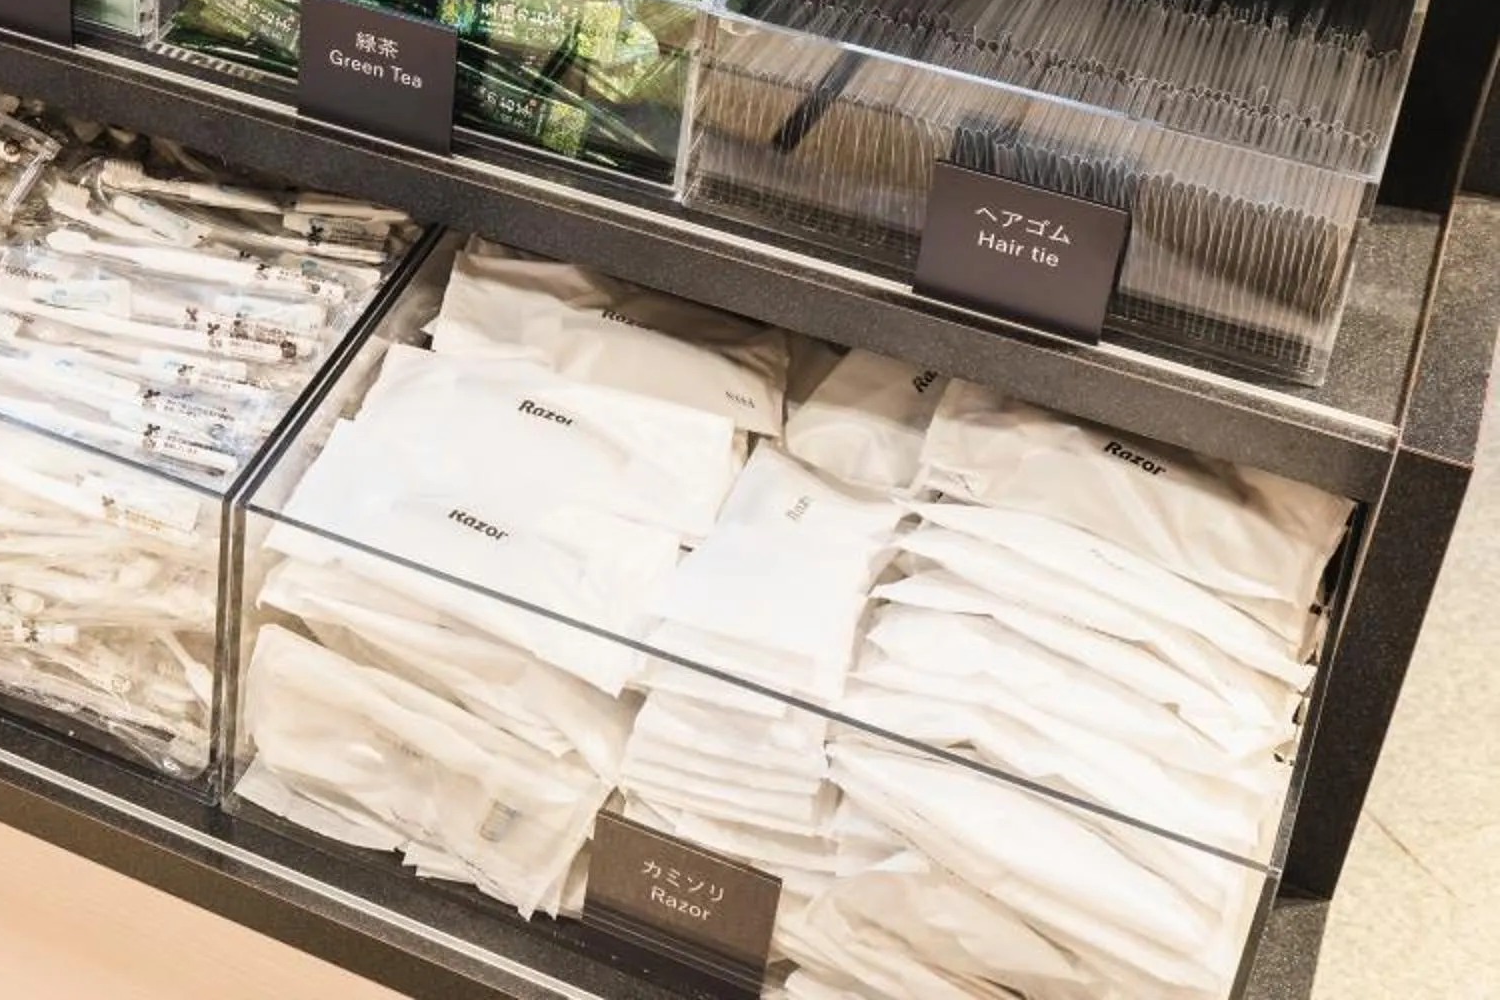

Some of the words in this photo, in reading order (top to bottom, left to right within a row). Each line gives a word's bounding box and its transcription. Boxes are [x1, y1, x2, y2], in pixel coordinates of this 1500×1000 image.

[355, 31, 399, 59] 緑茶
[329, 49, 384, 78] Green
[390, 65, 422, 88] Tea
[974, 208, 1070, 244] ヘアゴム
[978, 230, 1024, 256] Hair
[1031, 246, 1059, 267] tie
[517, 399, 573, 427] Razor
[1104, 441, 1167, 476] Razor
[448, 509, 509, 540] Razor
[642, 860, 724, 902] カミソリ
[651, 885, 711, 920] Razor
